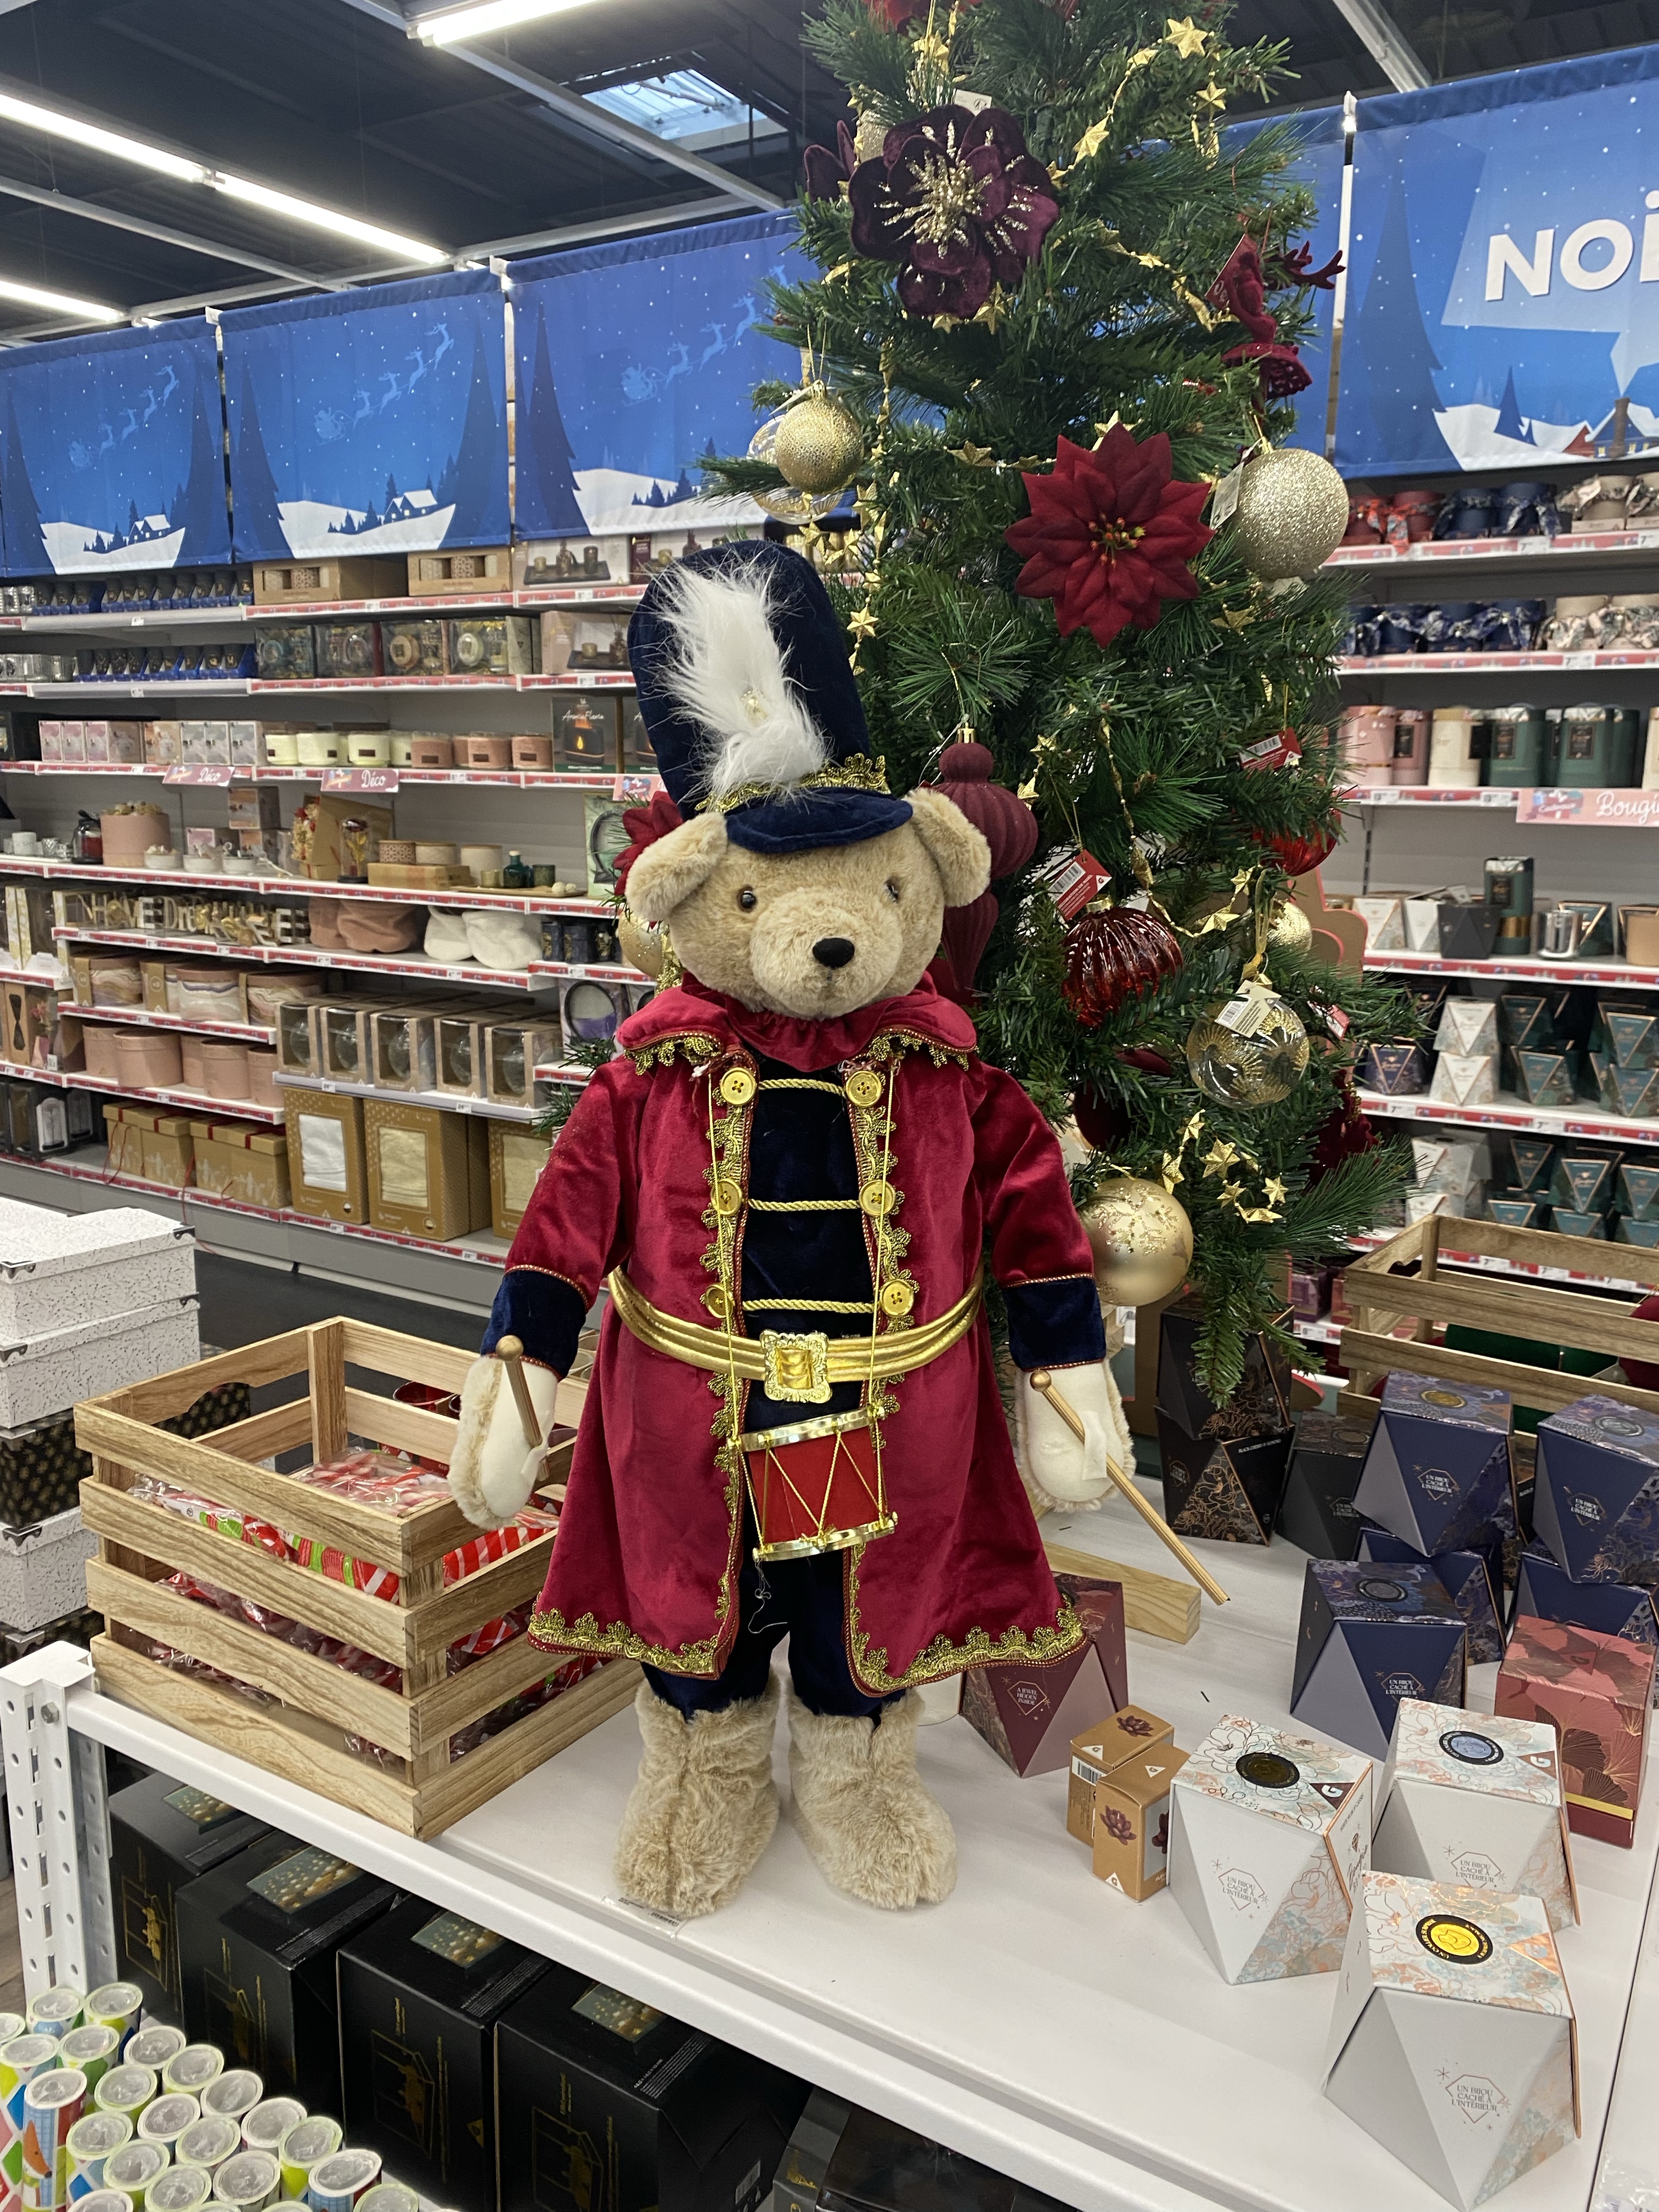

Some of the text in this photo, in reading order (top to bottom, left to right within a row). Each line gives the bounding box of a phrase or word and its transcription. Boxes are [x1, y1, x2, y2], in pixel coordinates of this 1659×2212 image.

[198, 768, 221, 783] Déco
[362, 769, 386, 788] Déco
[1530, 1756, 1551, 1768] G
[1321, 1785, 1344, 1797] G
[1111, 1877, 1118, 1887] G
[1238, 1880, 1255, 1890] BIJOU
[1471, 2087, 1493, 2096] BIJOU
